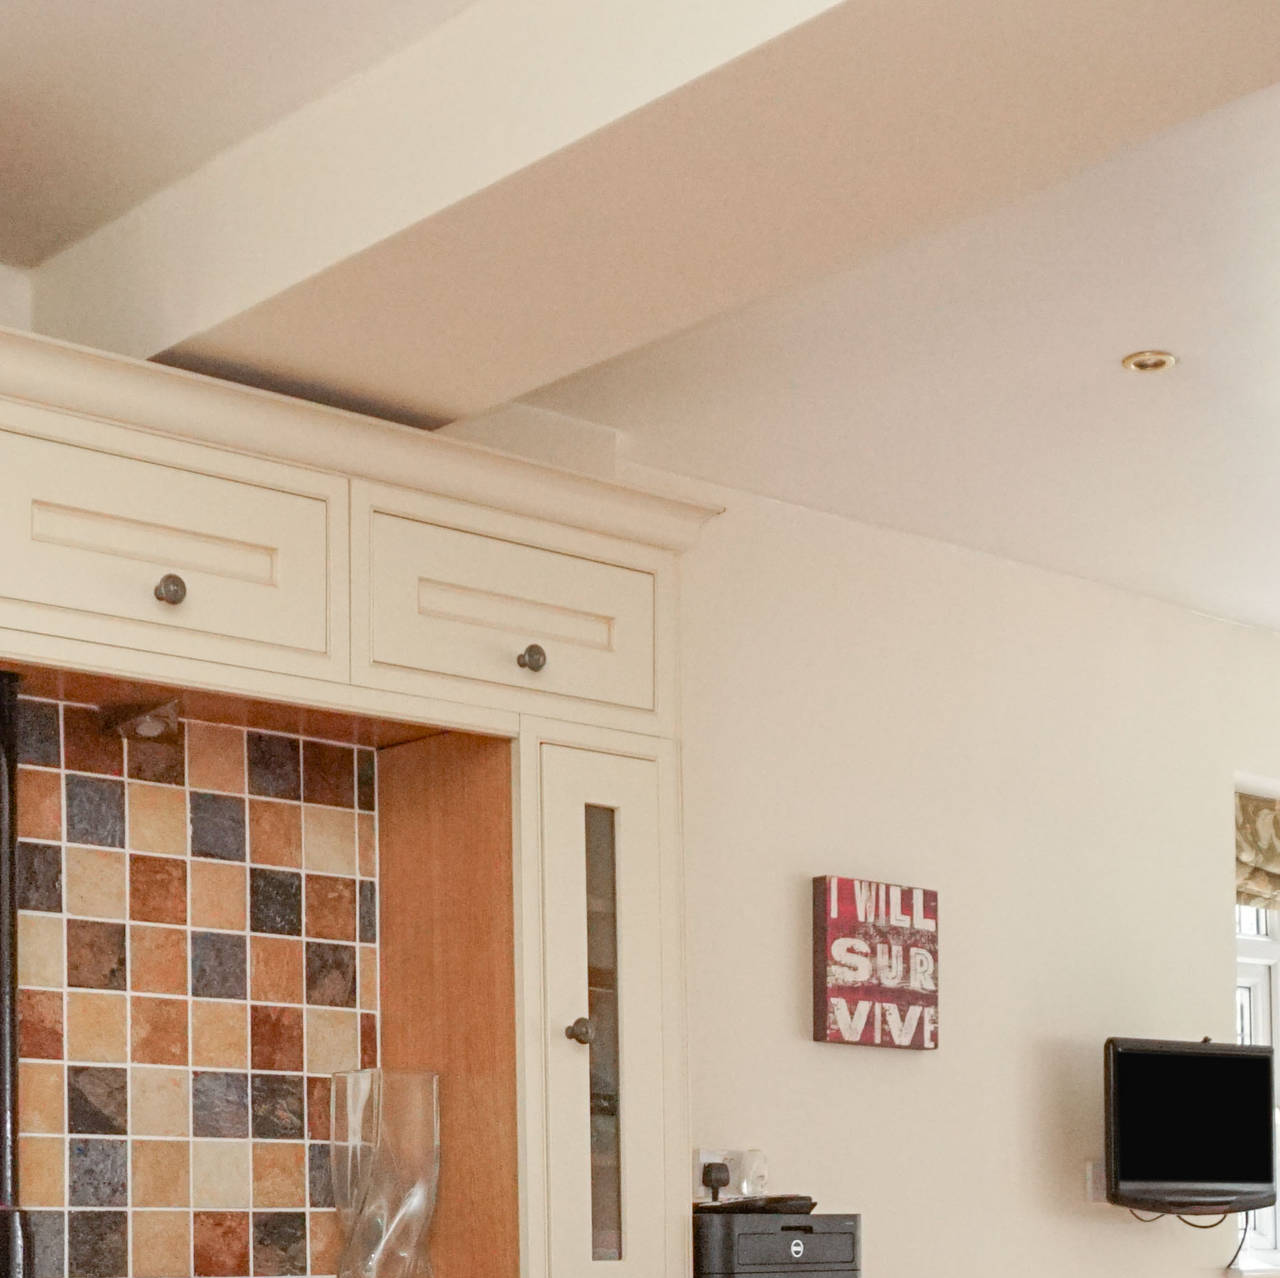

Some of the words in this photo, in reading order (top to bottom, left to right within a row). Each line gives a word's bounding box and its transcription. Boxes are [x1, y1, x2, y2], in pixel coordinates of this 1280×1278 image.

[830, 877, 839, 919] I
[853, 879, 937, 932] WILL
[829, 937, 937, 991] SUR
[830, 997, 937, 1049] VIVE
